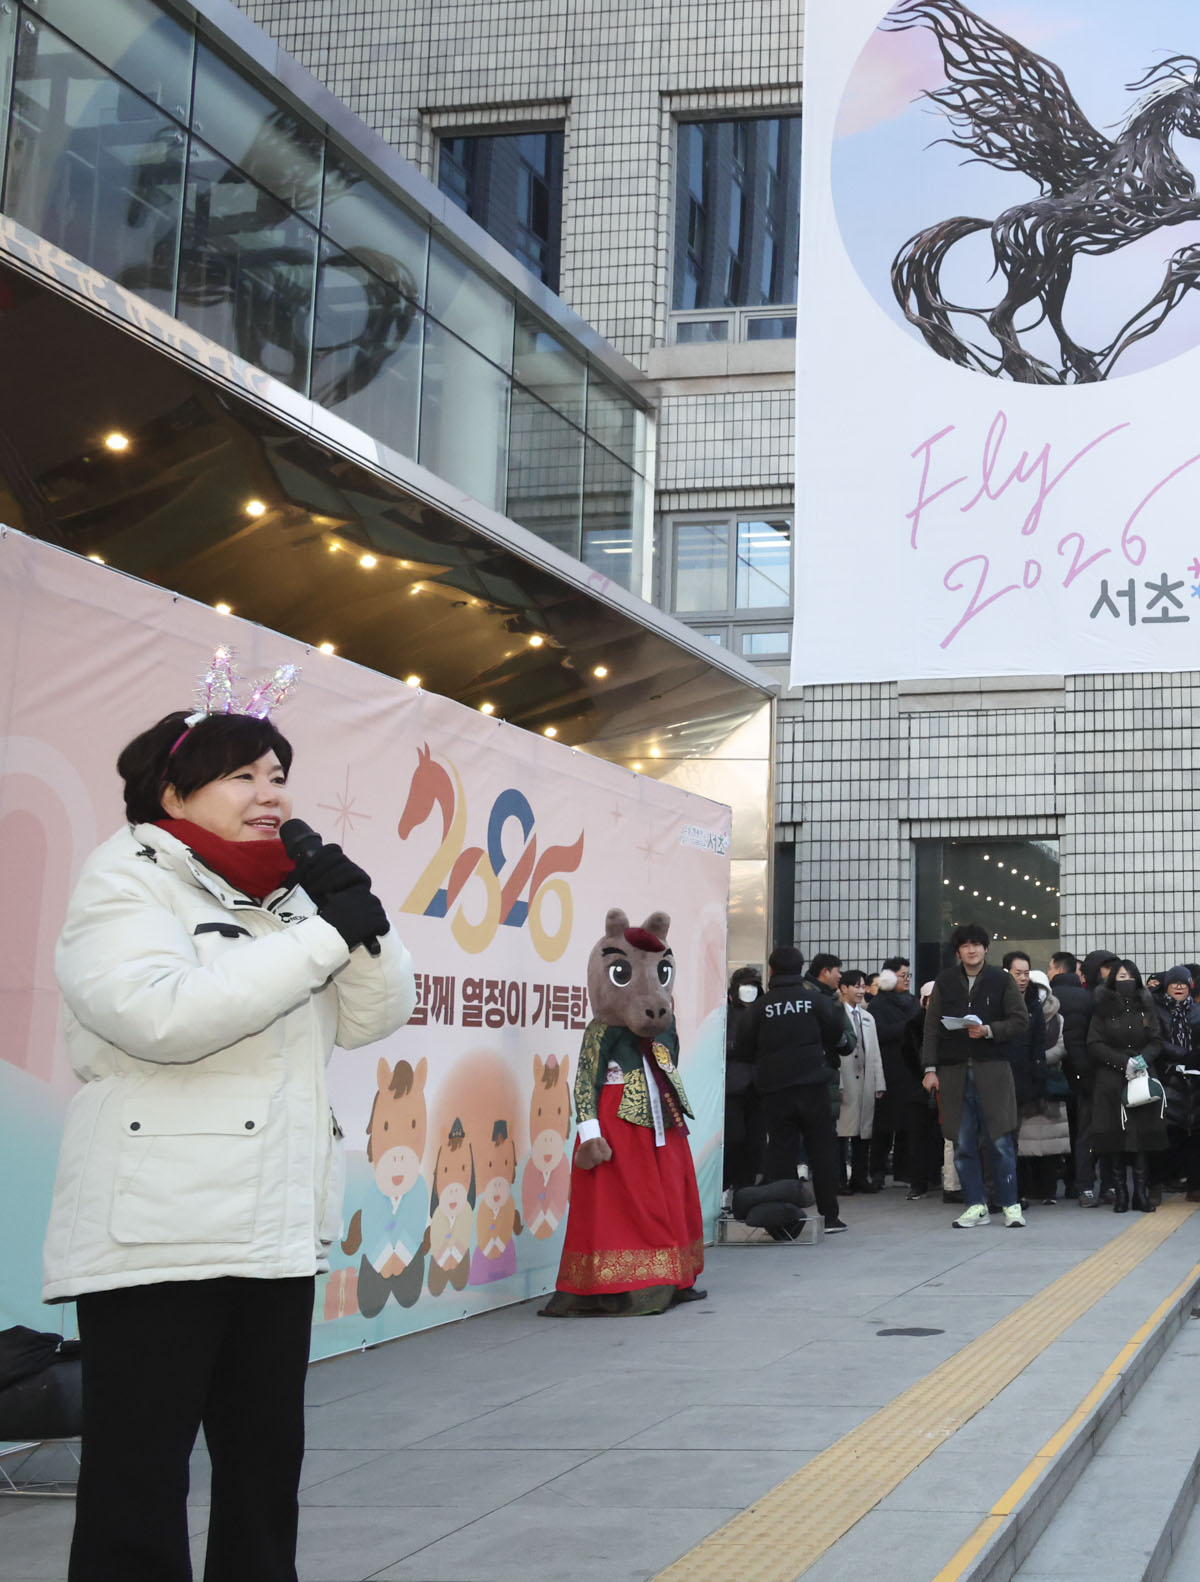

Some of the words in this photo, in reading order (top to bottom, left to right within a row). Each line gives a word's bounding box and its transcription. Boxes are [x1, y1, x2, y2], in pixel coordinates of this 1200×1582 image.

[906, 410, 1130, 549] Fly
[1089, 572, 1190, 626] 서초
[397, 741, 585, 963] 2026
[707, 832, 725, 855] 서초
[462, 977, 527, 1029] 열정이
[532, 983, 588, 1030] 가득한
[765, 1000, 812, 1018] STAFF
